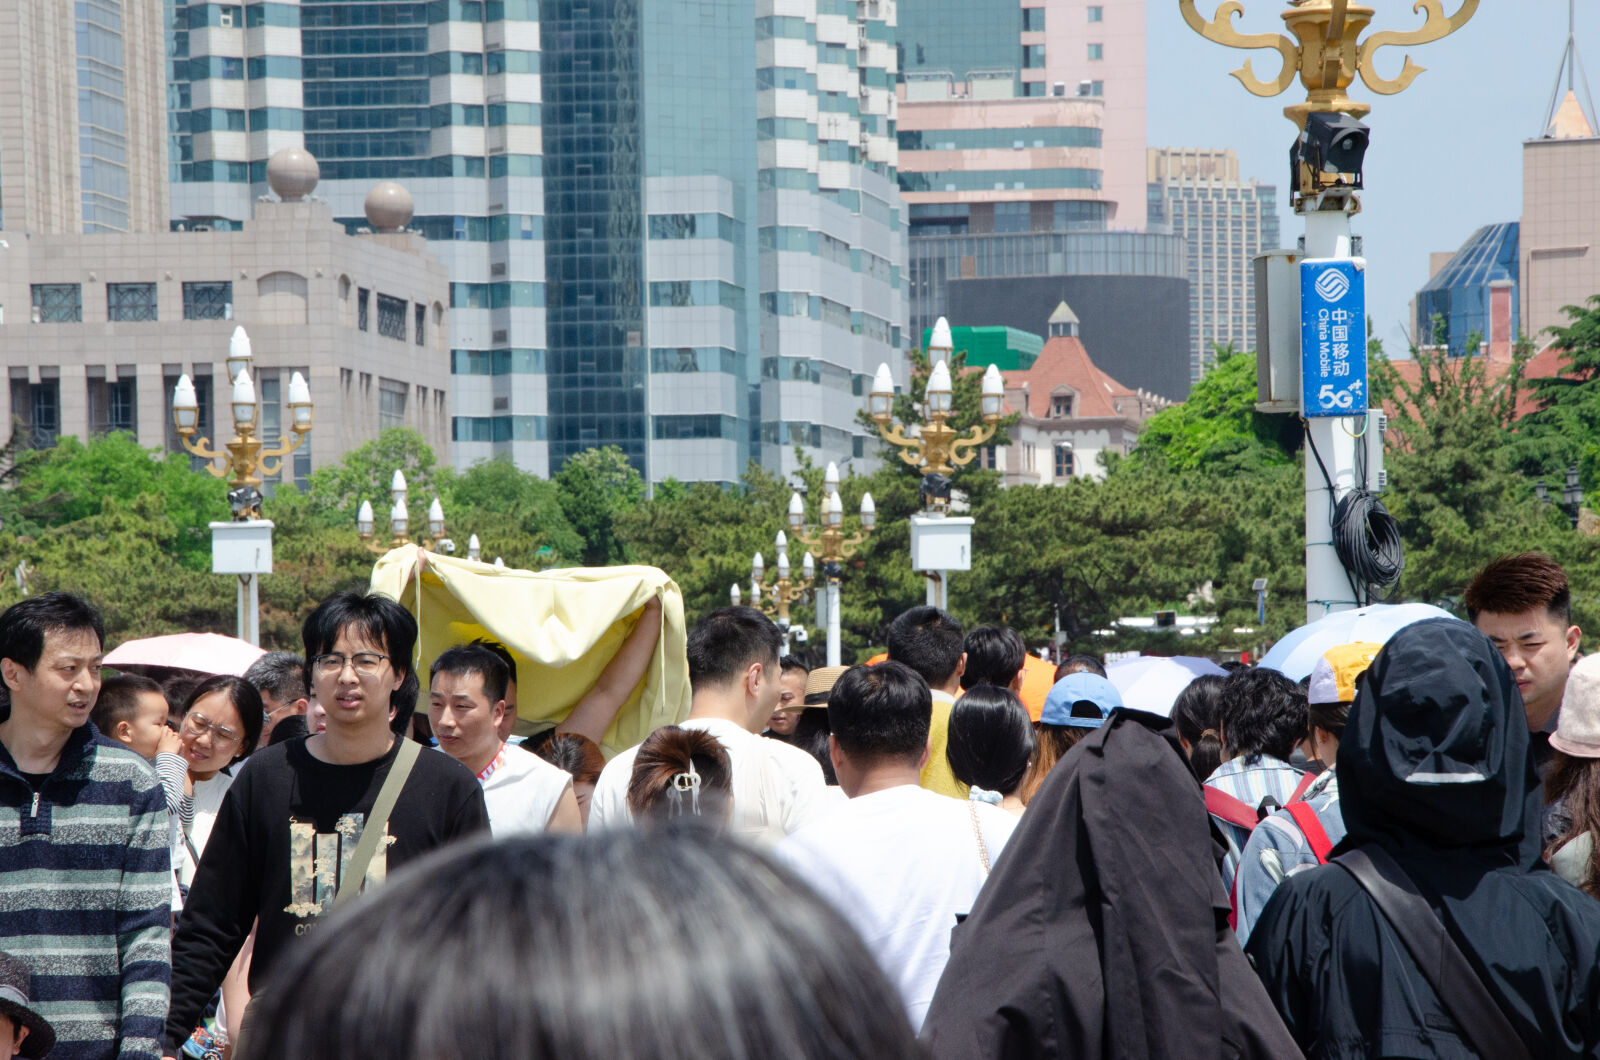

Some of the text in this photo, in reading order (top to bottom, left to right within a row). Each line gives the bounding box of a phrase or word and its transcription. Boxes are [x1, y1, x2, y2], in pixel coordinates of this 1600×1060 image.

[1318, 308, 1331, 378] China Mobile
[1331, 308, 1350, 377] 中国移动
